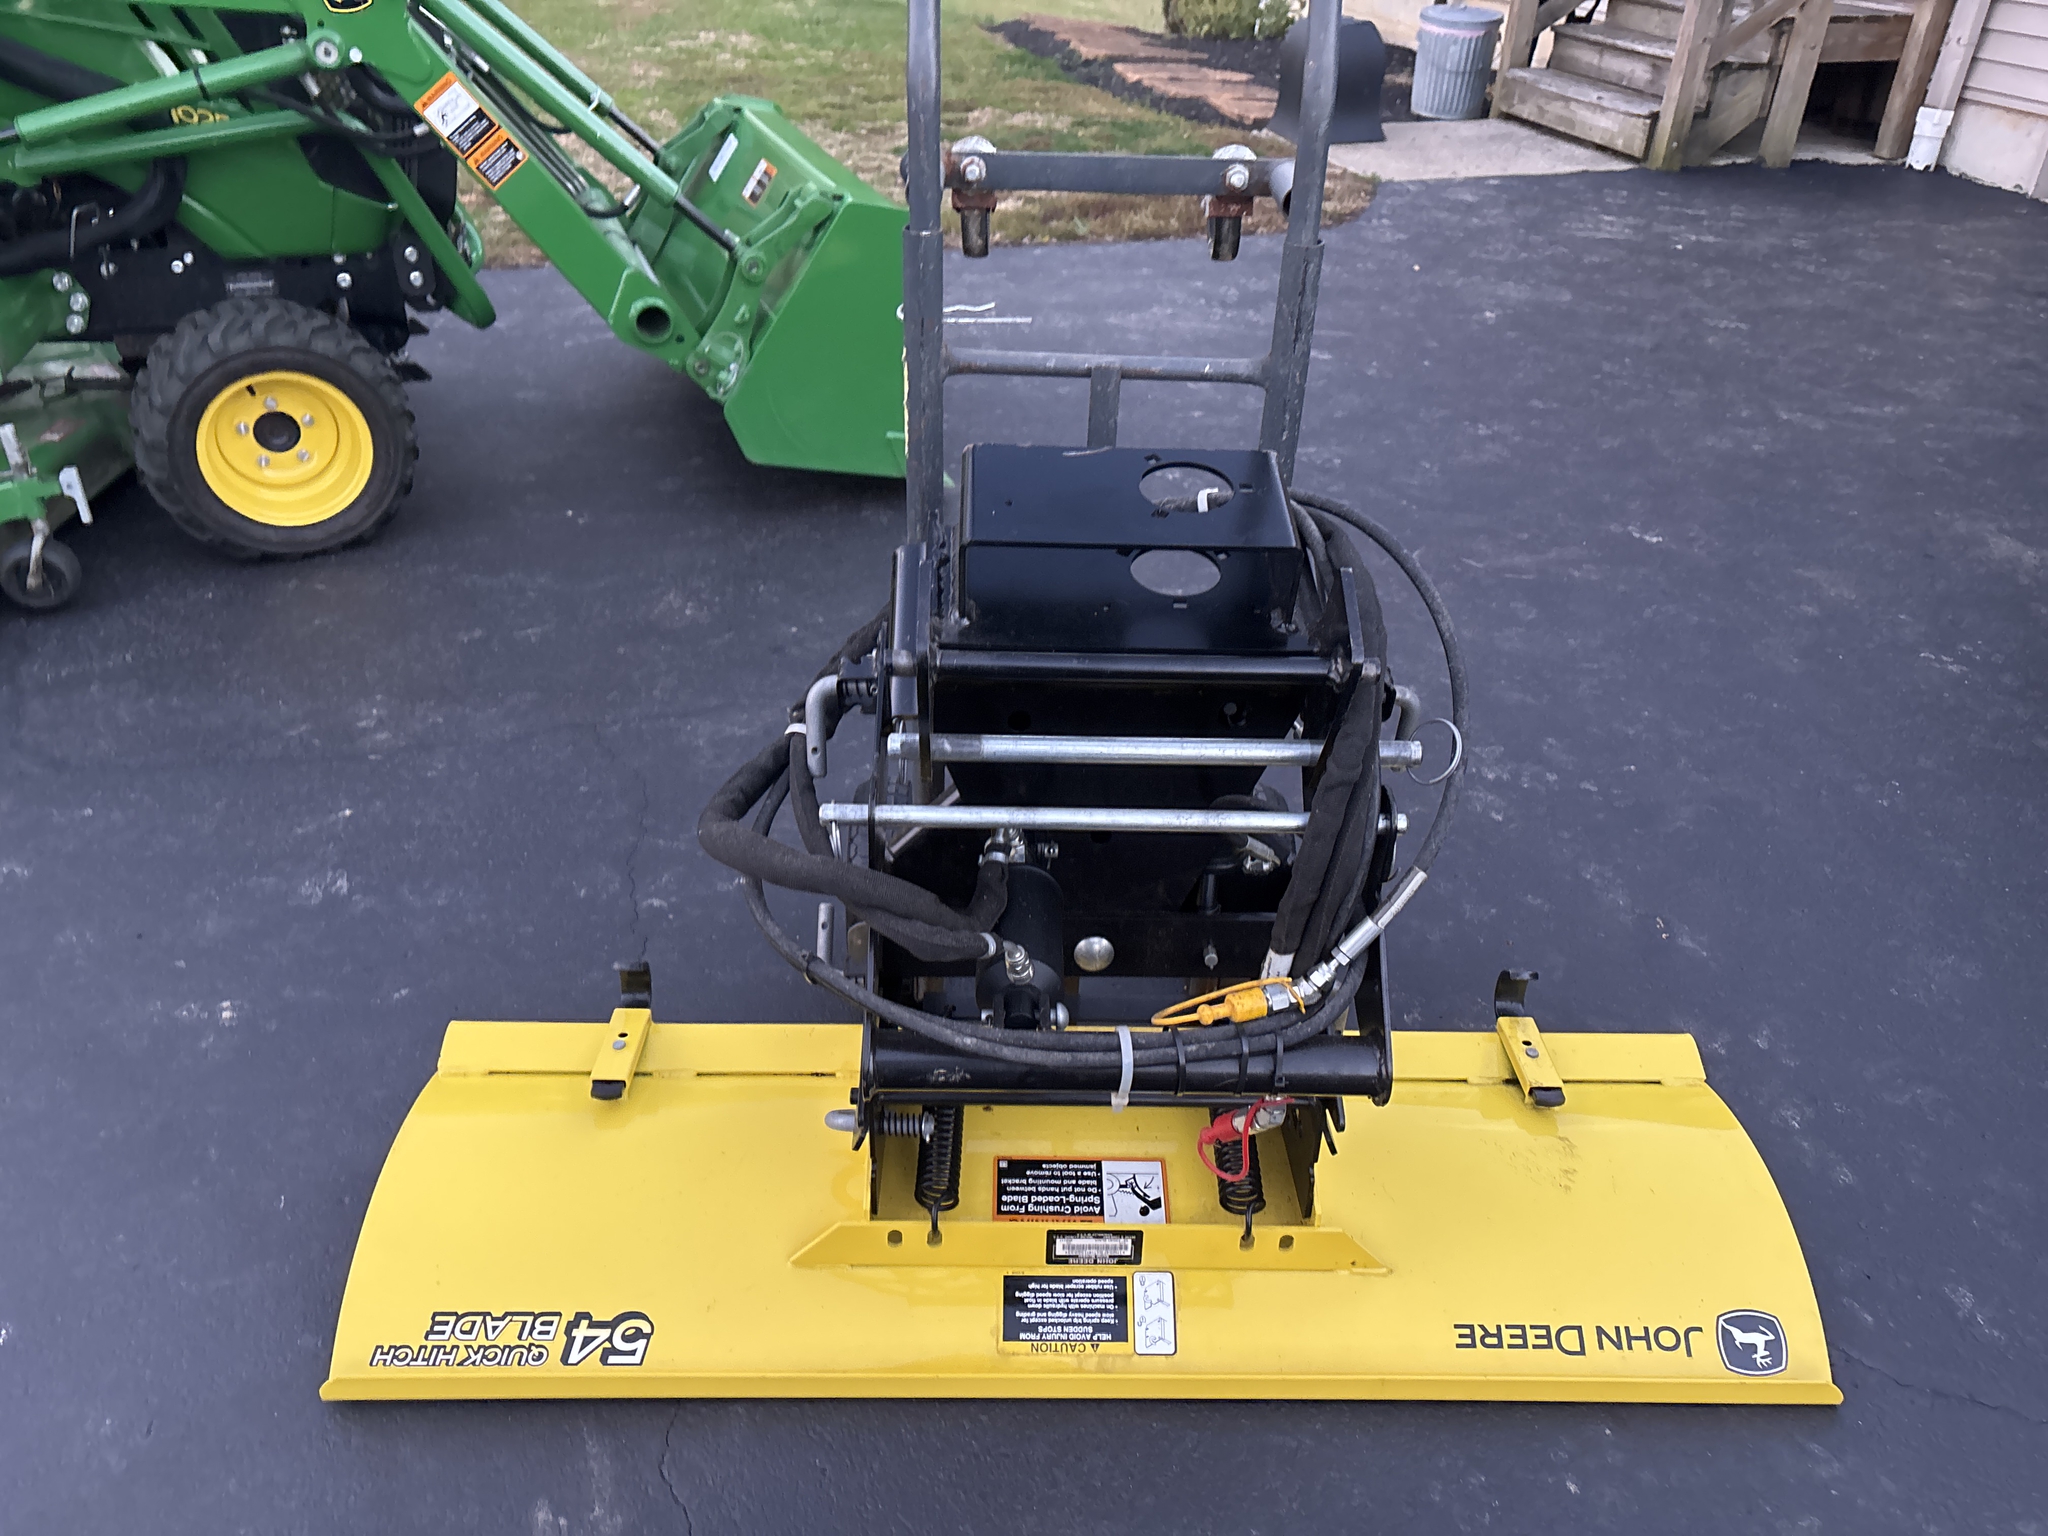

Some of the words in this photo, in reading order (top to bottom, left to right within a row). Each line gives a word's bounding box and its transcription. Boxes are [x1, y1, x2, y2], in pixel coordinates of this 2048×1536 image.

[1001, 1195, 1028, 1203] Blade
[1031, 1195, 1100, 1204] Spring-Loaded
[1001, 1205, 1025, 1213] From
[1028, 1204, 1071, 1213] Crushing
[1074, 1206, 1100, 1214] Avoid
[424, 1312, 562, 1341] BLADE
[560, 1311, 654, 1366] 54
[1453, 1323, 1586, 1357] DEERE
[1596, 1325, 1703, 1358] JOHN
[369, 1345, 458, 1367] HITCH
[457, 1343, 549, 1367] QUICK
[1031, 1343, 1086, 1353] CAUTION
